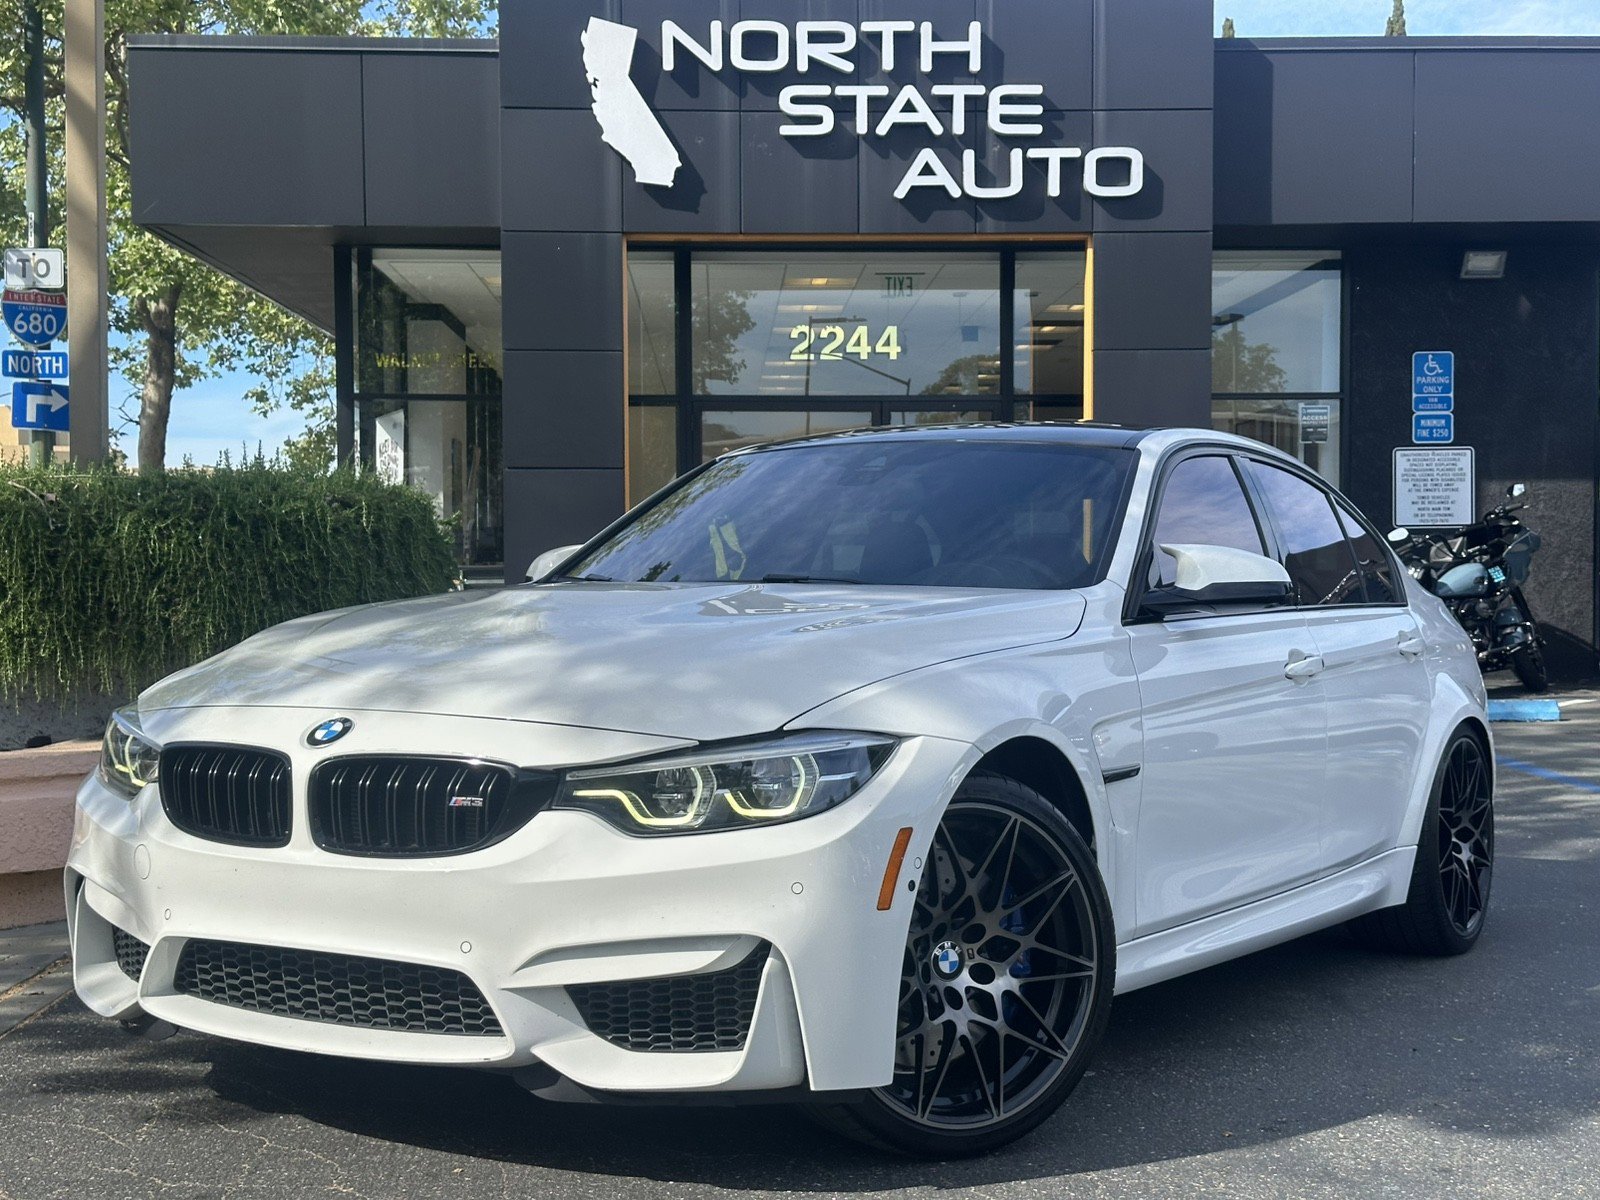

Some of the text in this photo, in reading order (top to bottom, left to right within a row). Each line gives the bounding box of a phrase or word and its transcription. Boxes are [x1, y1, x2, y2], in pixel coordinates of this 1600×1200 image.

[661, 20, 982, 73] NORTH
[778, 84, 1044, 136] STATE
[893, 147, 1144, 199] AUTO
[17, 258, 51, 278] TO
[9, 292, 61, 304] INTERSTATE
[14, 312, 57, 335] 680
[790, 325, 902, 360] 2244
[8, 354, 63, 375] NORTH
[1416, 376, 1450, 384] PARKING
[1417, 429, 1430, 437] FINE
[934, 942, 961, 955] BMW
